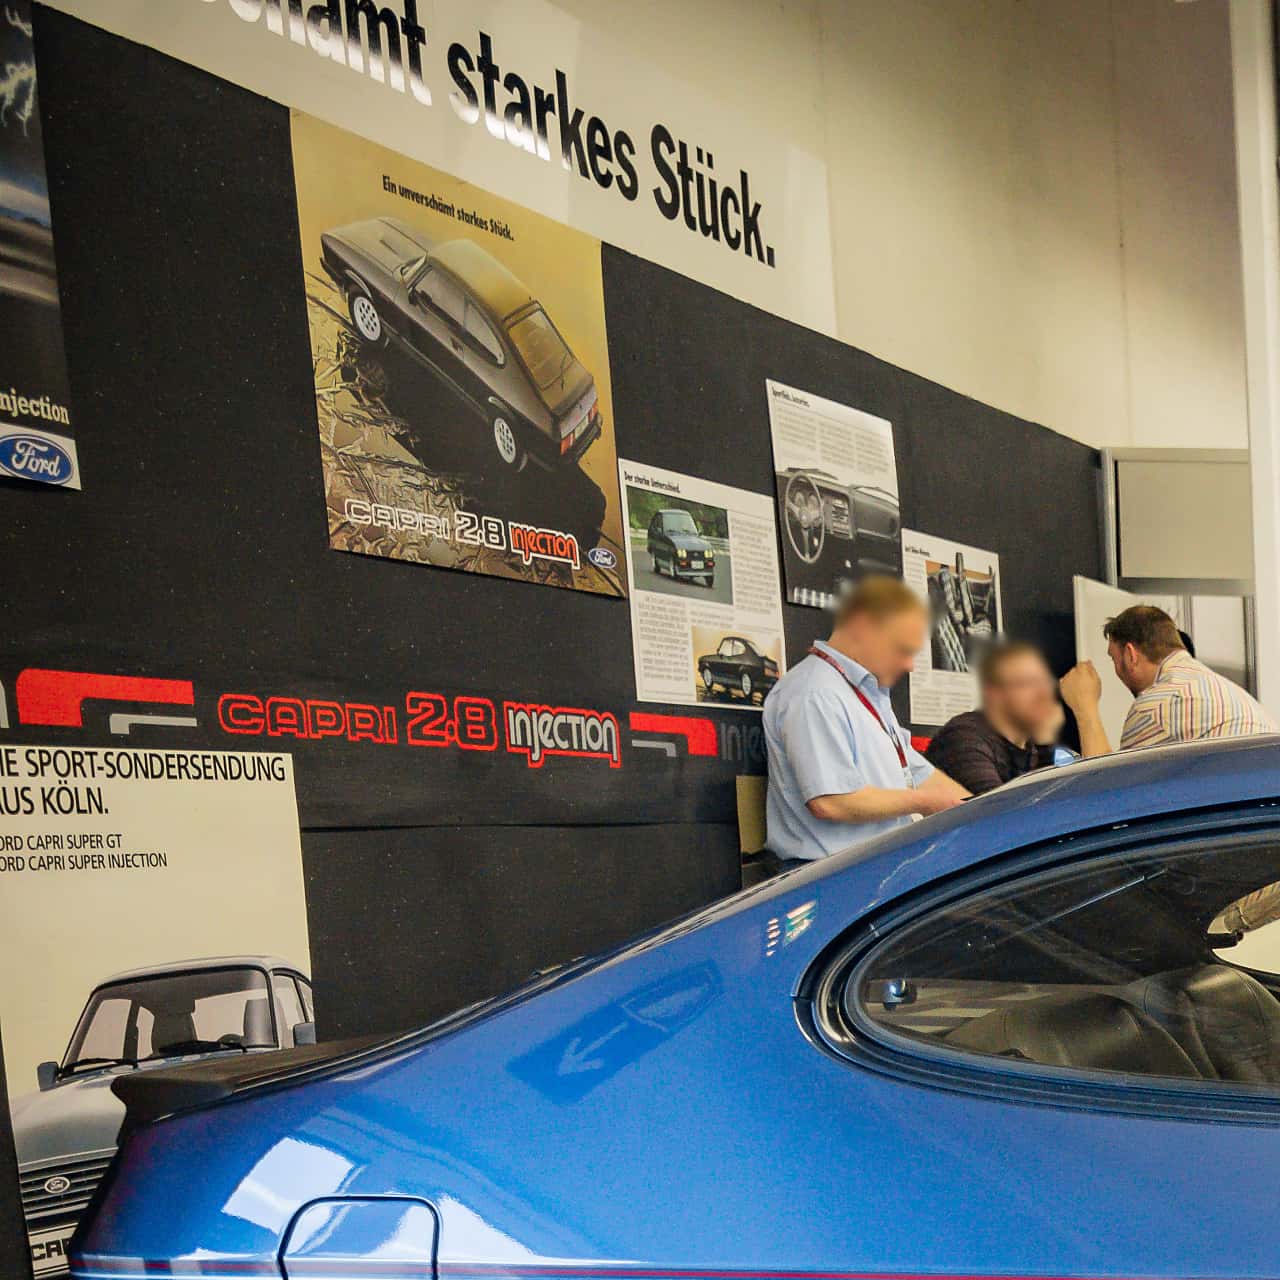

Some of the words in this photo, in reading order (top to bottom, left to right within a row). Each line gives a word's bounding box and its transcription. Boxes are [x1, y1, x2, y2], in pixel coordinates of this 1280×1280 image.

[447, 31, 640, 201] starkes
[651, 123, 776, 268] Stück.
[382, 174, 397, 195] Ein
[398, 184, 455, 217] unverschämt
[456, 208, 489, 231] starkes
[489, 218, 515, 242] Stück.
[10, 439, 61, 478] Ford
[345, 499, 451, 540] CAPRI
[454, 511, 507, 551] 2.8
[217, 693, 398, 745] CAPRI
[406, 692, 498, 751] 2.8
[25, 749, 286, 782] SPORT-SONDERSENDUNG
[40, 780, 109, 815] KÖLN.
[27, 834, 64, 850] CAPRI
[66, 834, 104, 850] SUPER
[106, 833, 122, 849] GT
[28, 855, 66, 871] CAPRI
[68, 853, 106, 870] SUPER
[108, 852, 168, 869] INJECTION
